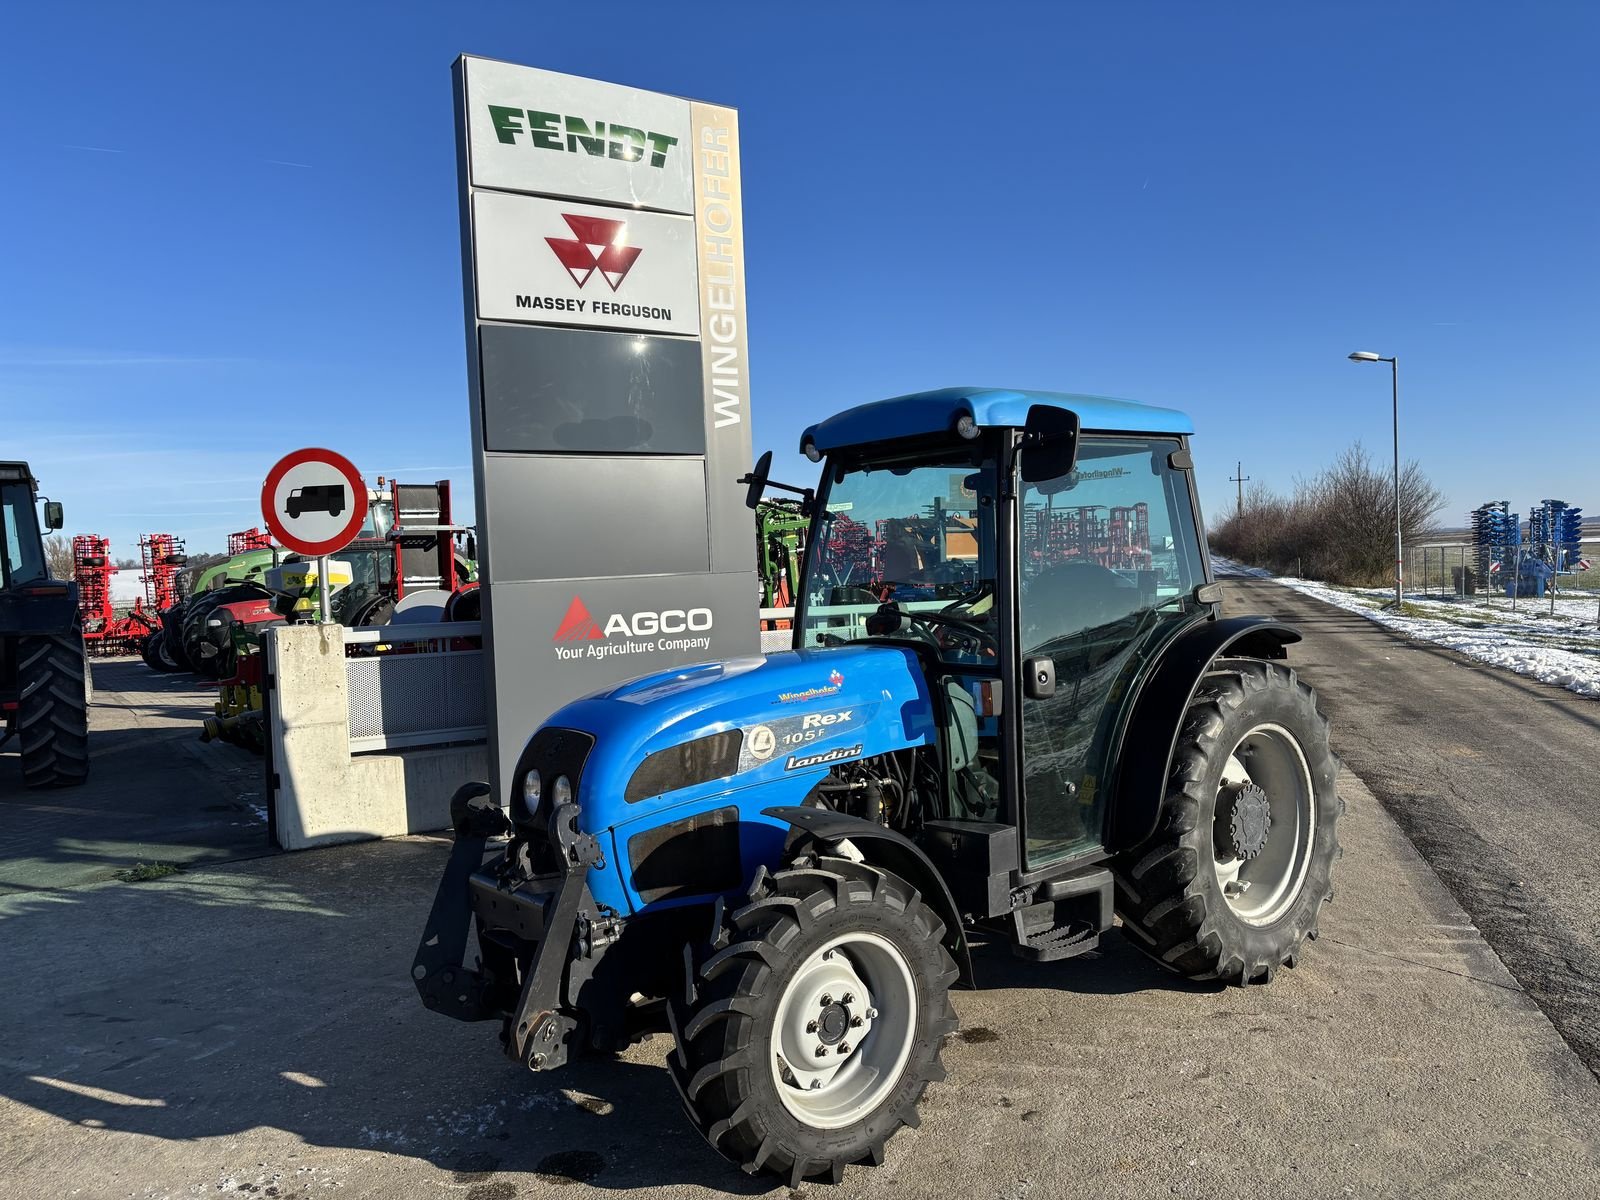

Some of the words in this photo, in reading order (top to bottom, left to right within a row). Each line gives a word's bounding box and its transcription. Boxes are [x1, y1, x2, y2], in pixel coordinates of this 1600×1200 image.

[487, 104, 679, 169] FENDT
[702, 127, 741, 429] WINGELHOFER
[515, 295, 586, 313] MASSEY
[592, 301, 672, 321] FERGUSON
[603, 607, 713, 638] AGCO
[555, 646, 584, 660] Your
[587, 641, 654, 659] Agriculture
[658, 637, 711, 652] Company
[802, 710, 853, 730] Rex
[782, 731, 816, 745] 105
[818, 728, 825, 737] F
[786, 744, 863, 770] Landini
